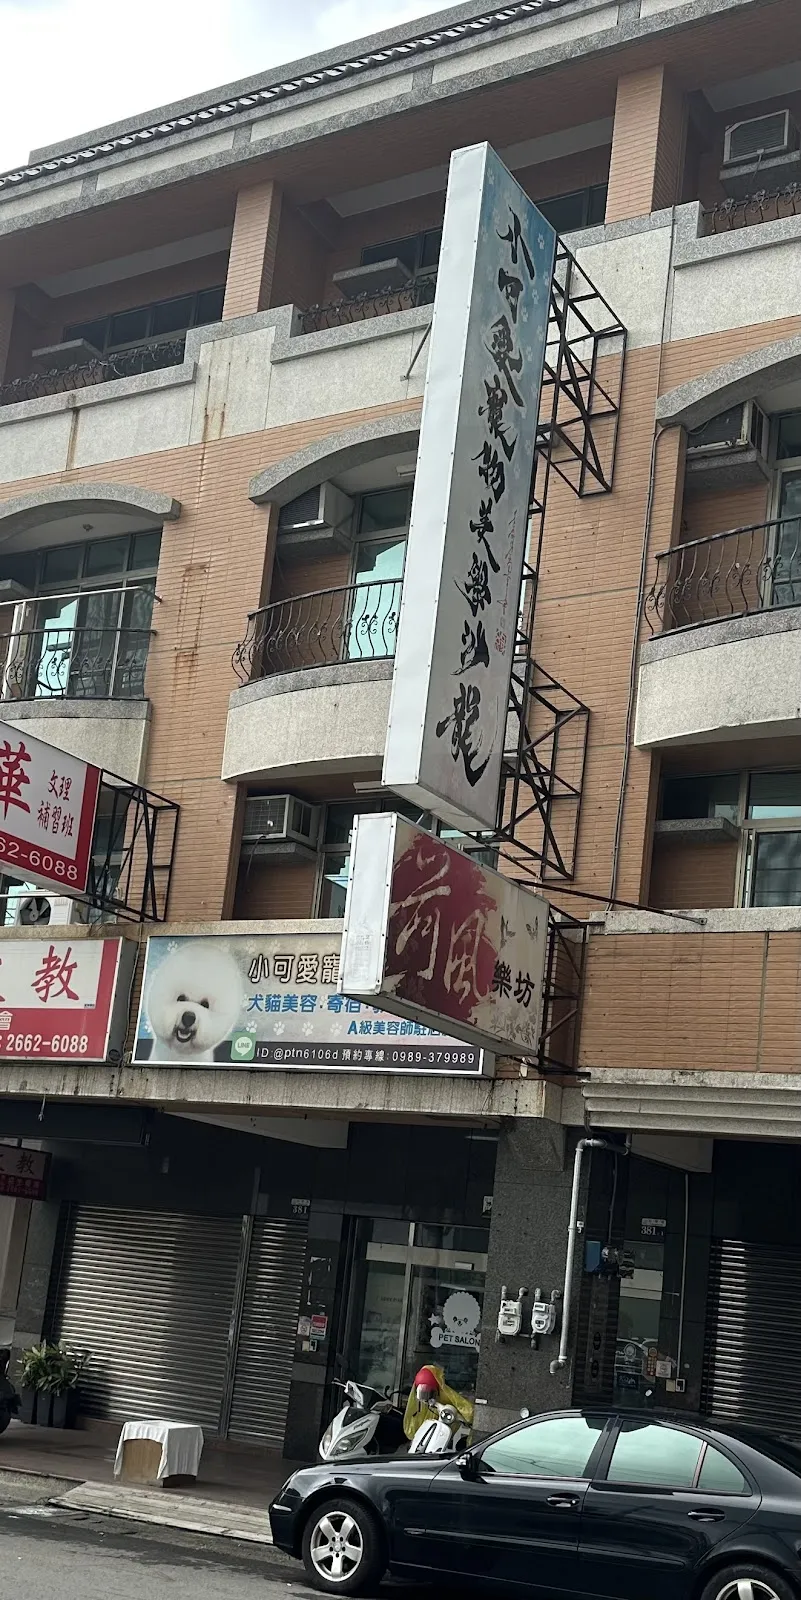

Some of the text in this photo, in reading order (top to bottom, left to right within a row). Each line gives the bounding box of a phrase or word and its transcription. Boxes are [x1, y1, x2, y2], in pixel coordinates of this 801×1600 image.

[48, 769, 73, 801] 文理
[37, 800, 75, 837] 補習班
[292, 1206, 308, 1214] 381
[438, 1334, 480, 1346] PET SALON
